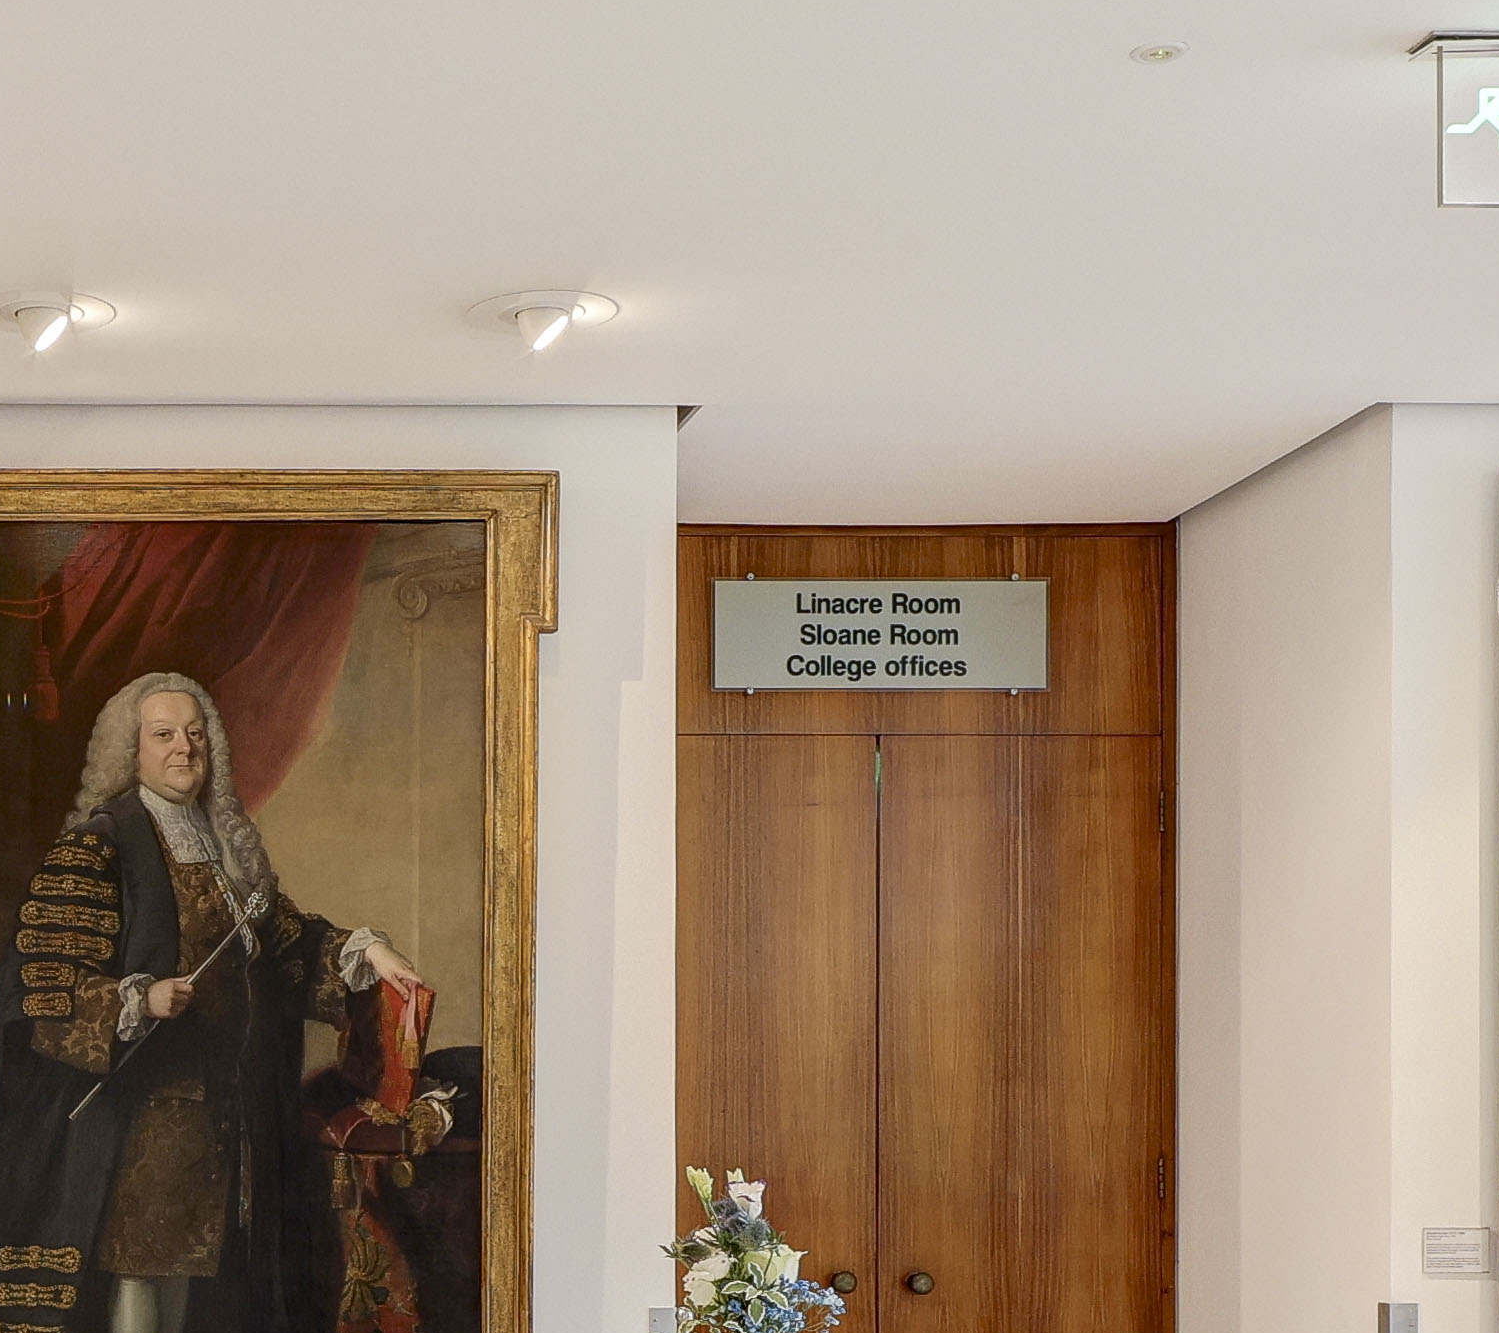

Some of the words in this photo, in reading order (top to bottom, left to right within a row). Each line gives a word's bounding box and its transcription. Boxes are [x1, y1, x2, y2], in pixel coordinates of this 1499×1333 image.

[796, 593, 883, 615] Linacre
[891, 593, 961, 615] Room
[799, 623, 882, 646] Sloane
[890, 624, 959, 646] Room
[786, 655, 877, 681] College
[884, 655, 968, 677] offices
